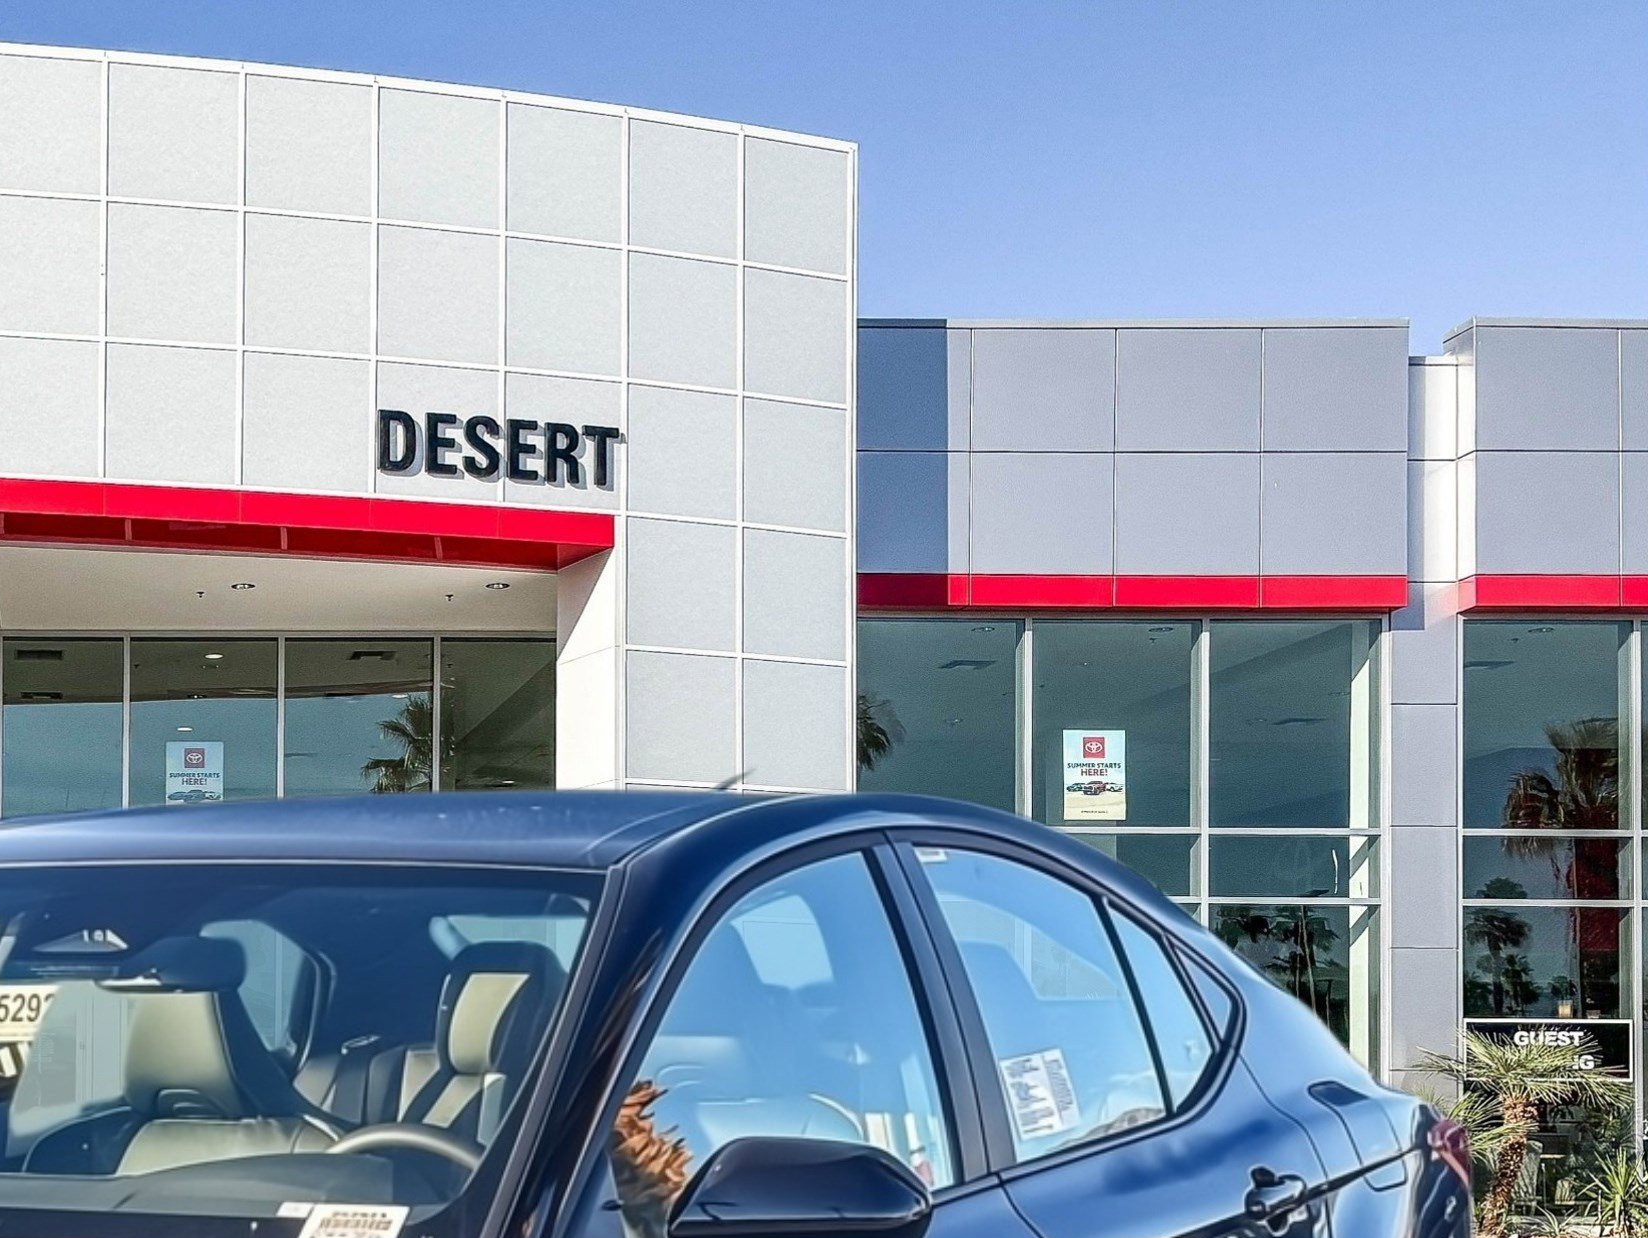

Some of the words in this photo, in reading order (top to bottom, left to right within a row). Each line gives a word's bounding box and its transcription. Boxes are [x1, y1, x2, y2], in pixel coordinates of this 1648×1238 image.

[377, 409, 620, 487] DESERT
[181, 777, 207, 786] HERE!
[1513, 1030, 1584, 1047] GUEST
